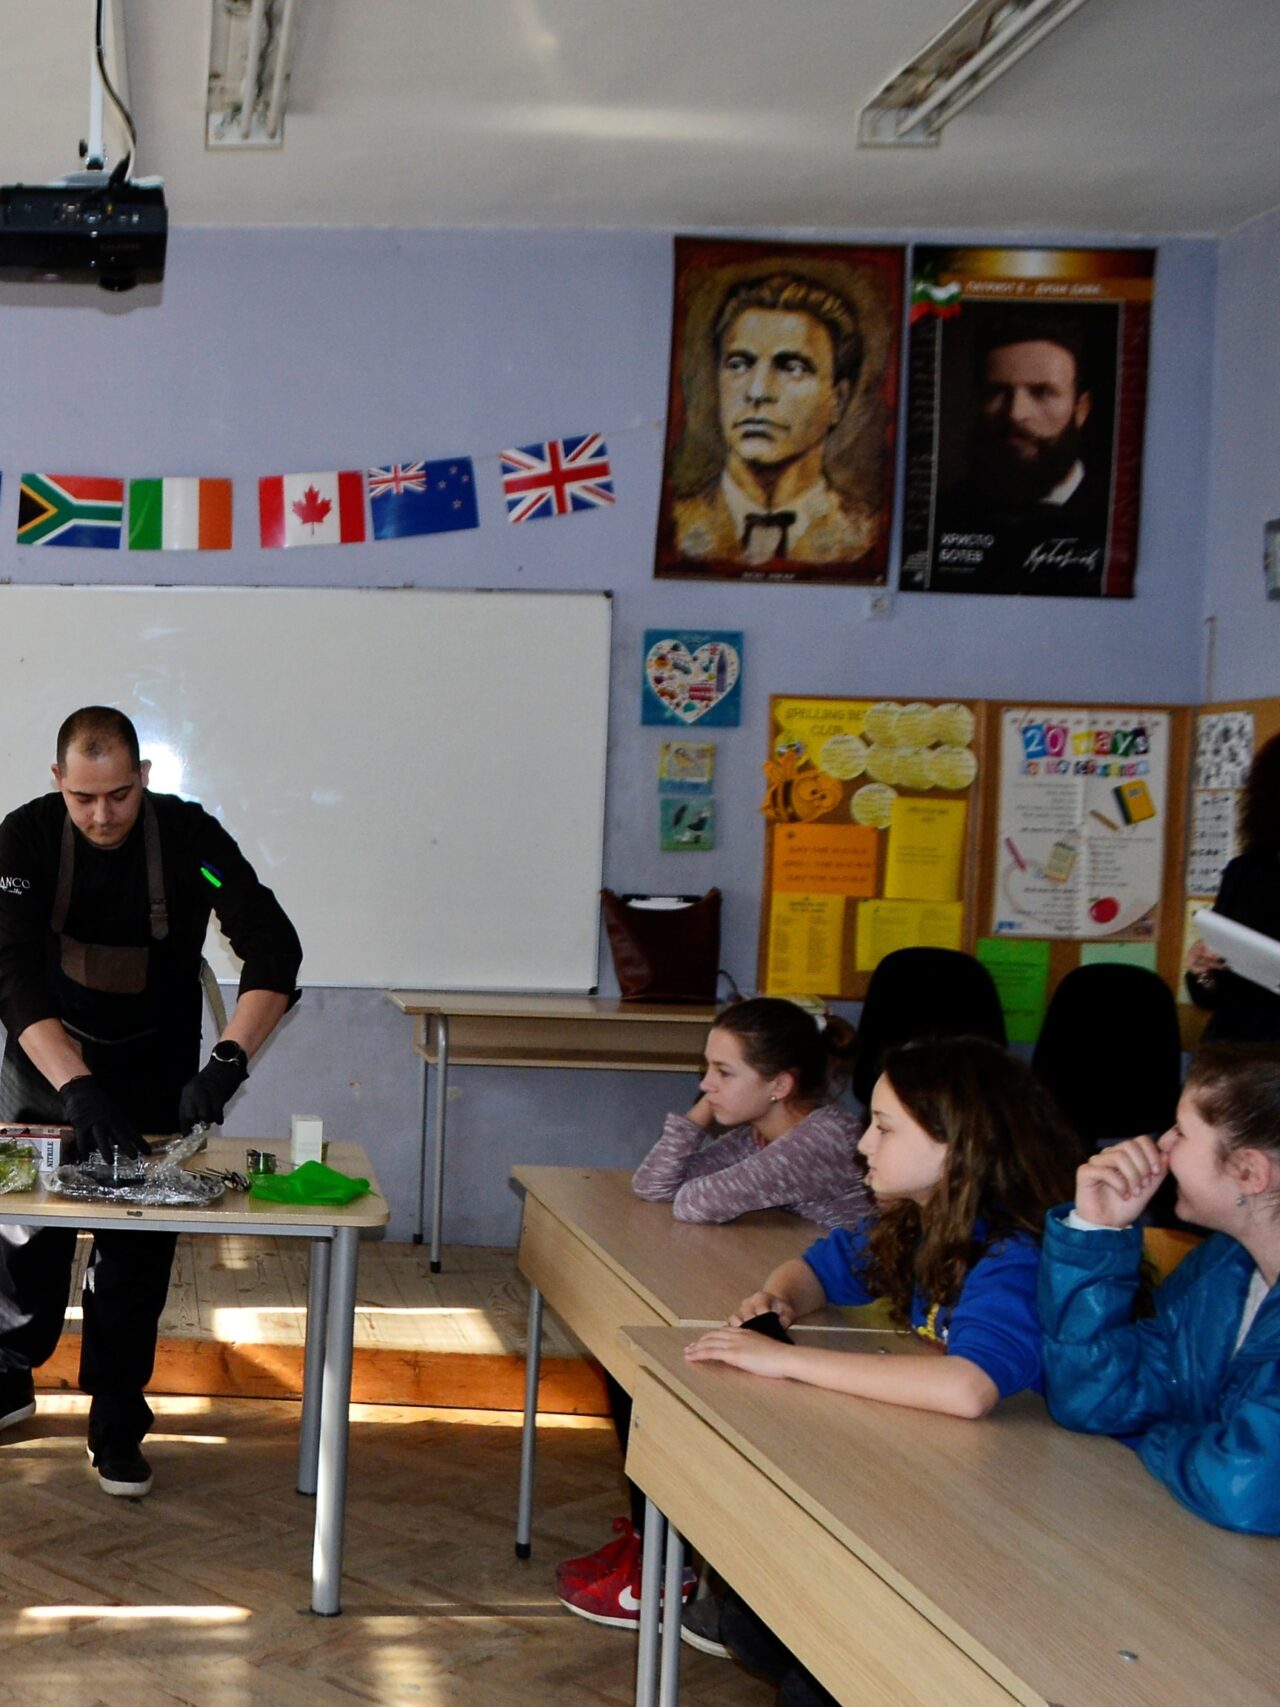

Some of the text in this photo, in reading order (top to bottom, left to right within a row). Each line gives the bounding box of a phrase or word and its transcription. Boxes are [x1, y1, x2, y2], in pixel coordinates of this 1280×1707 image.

[785, 707, 867, 721] SPELLING BE
[1023, 725, 1068, 756] 20
